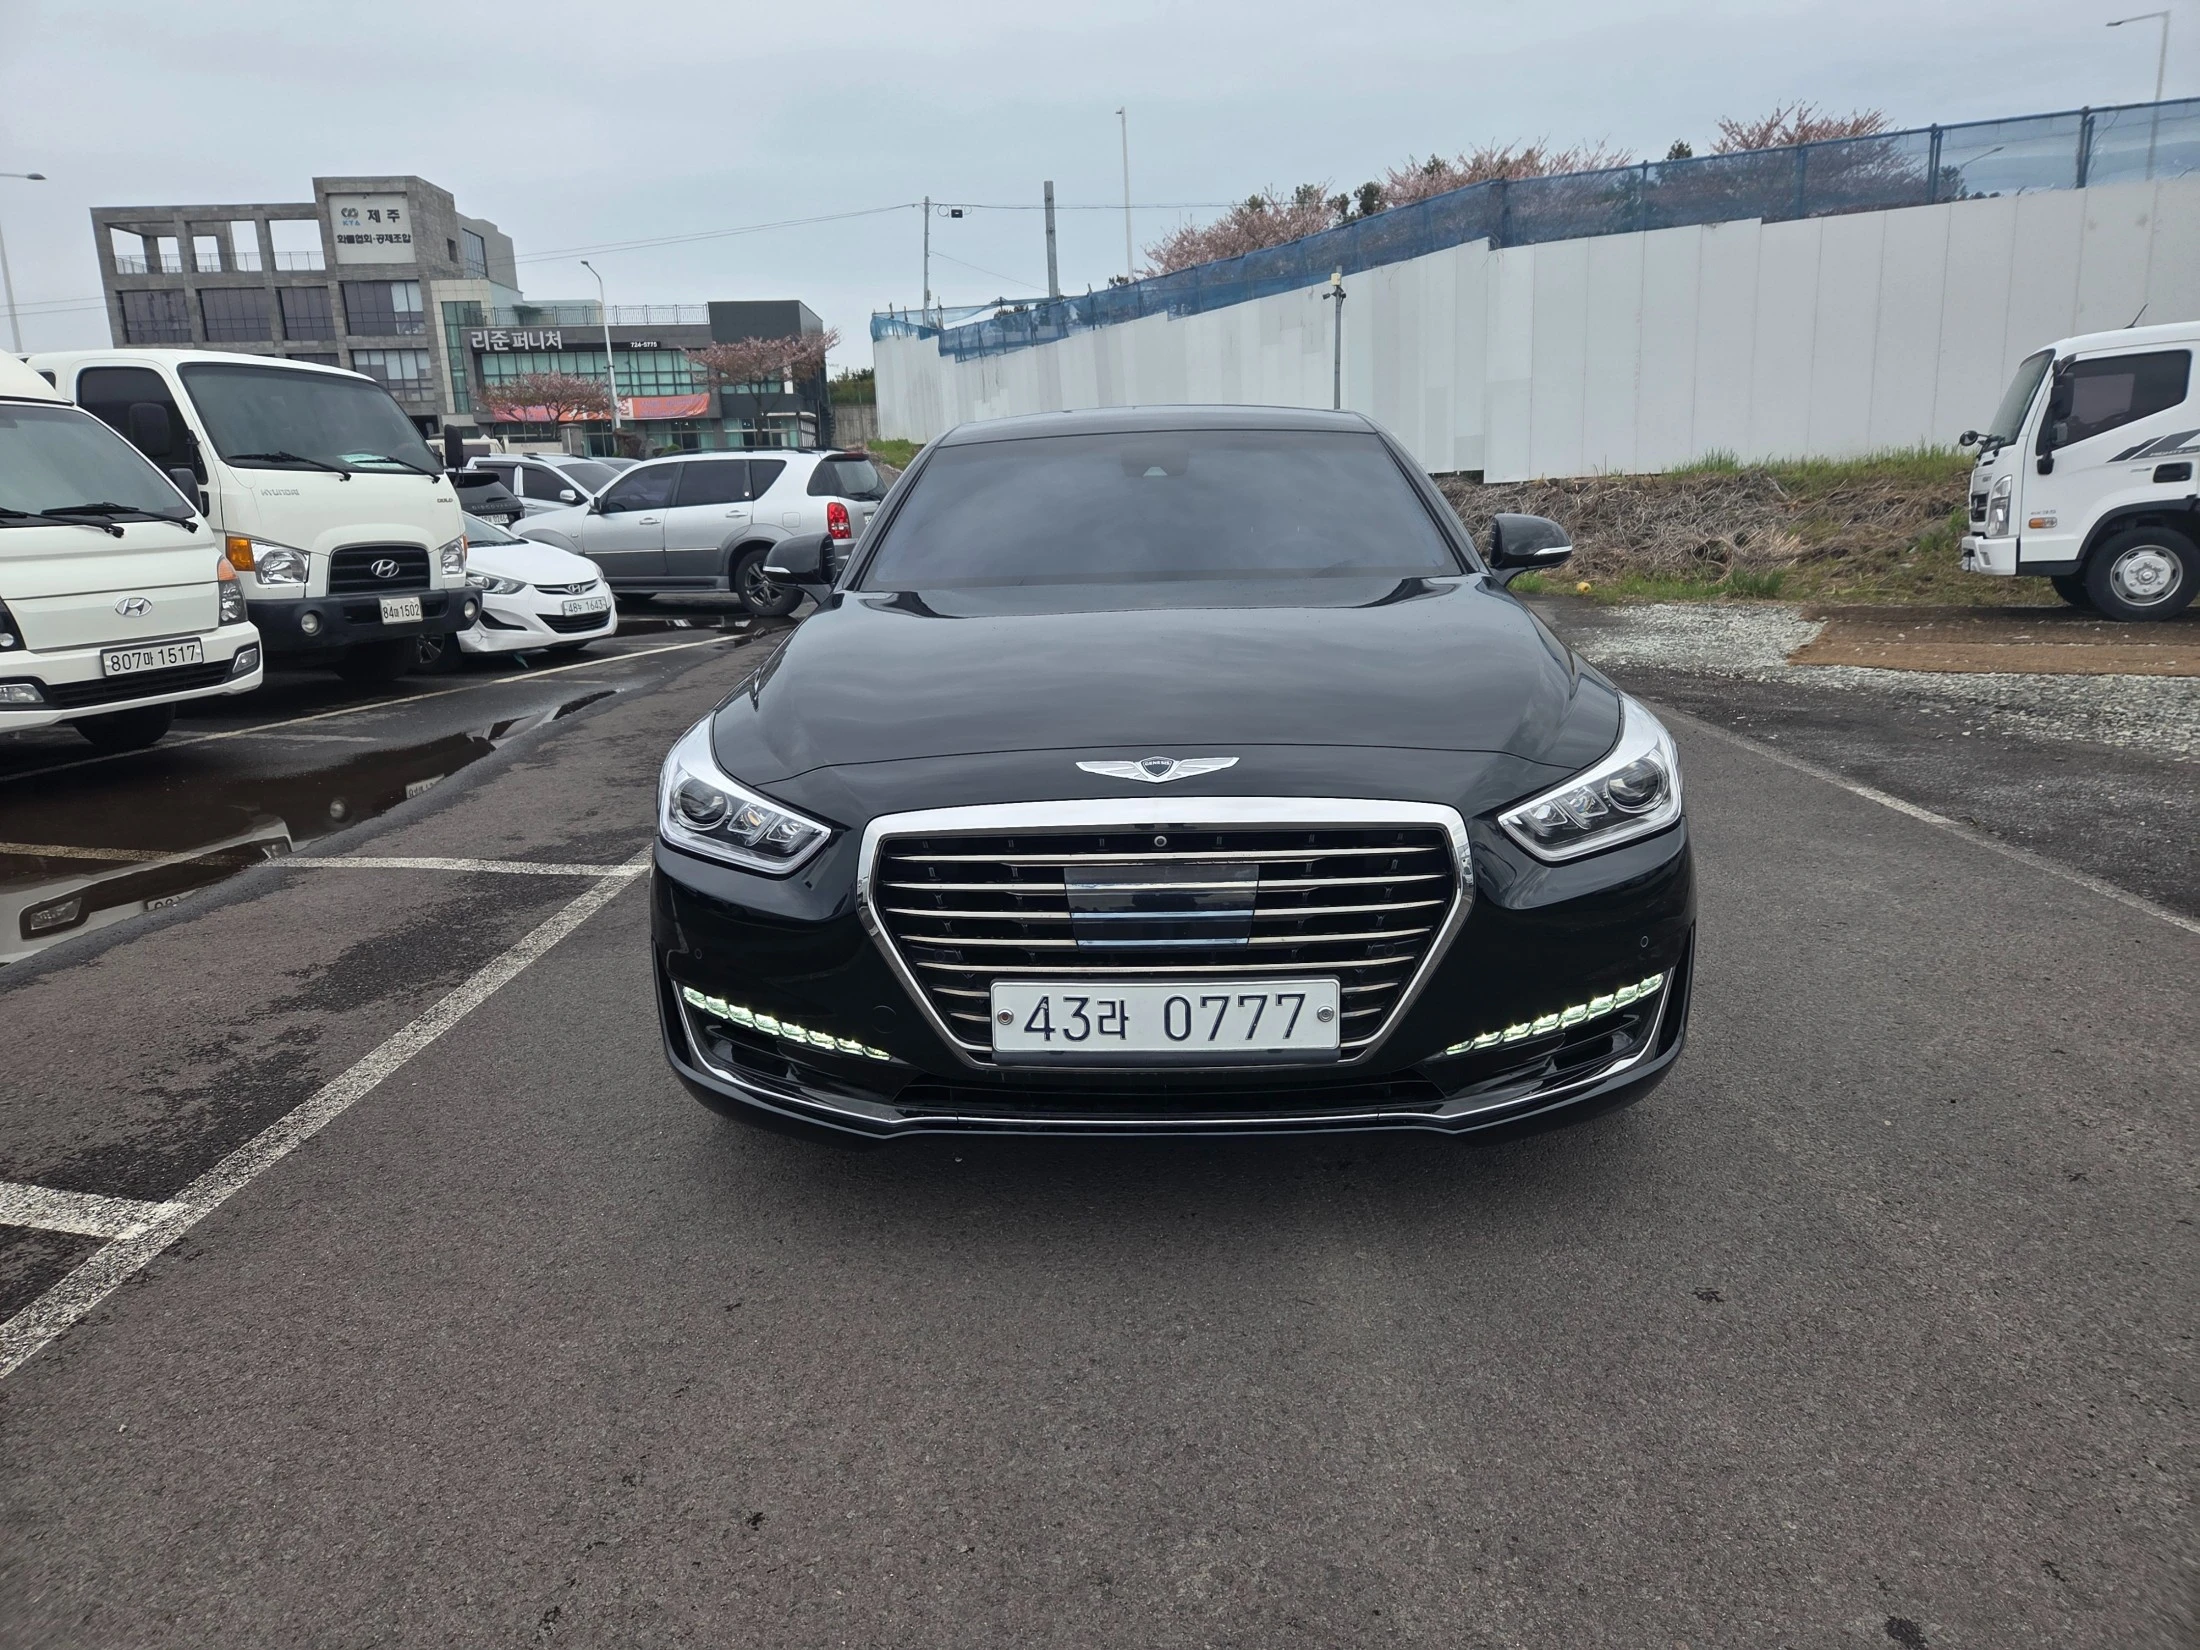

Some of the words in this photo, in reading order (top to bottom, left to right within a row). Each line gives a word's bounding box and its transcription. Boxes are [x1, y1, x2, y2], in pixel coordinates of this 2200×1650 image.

[260, 488, 300, 496] HYUNDAI
[586, 599, 604, 611] 1643
[158, 644, 196, 666] 1517
[1023, 995, 1130, 1042] 43라
[1163, 993, 1307, 1042] 0777
